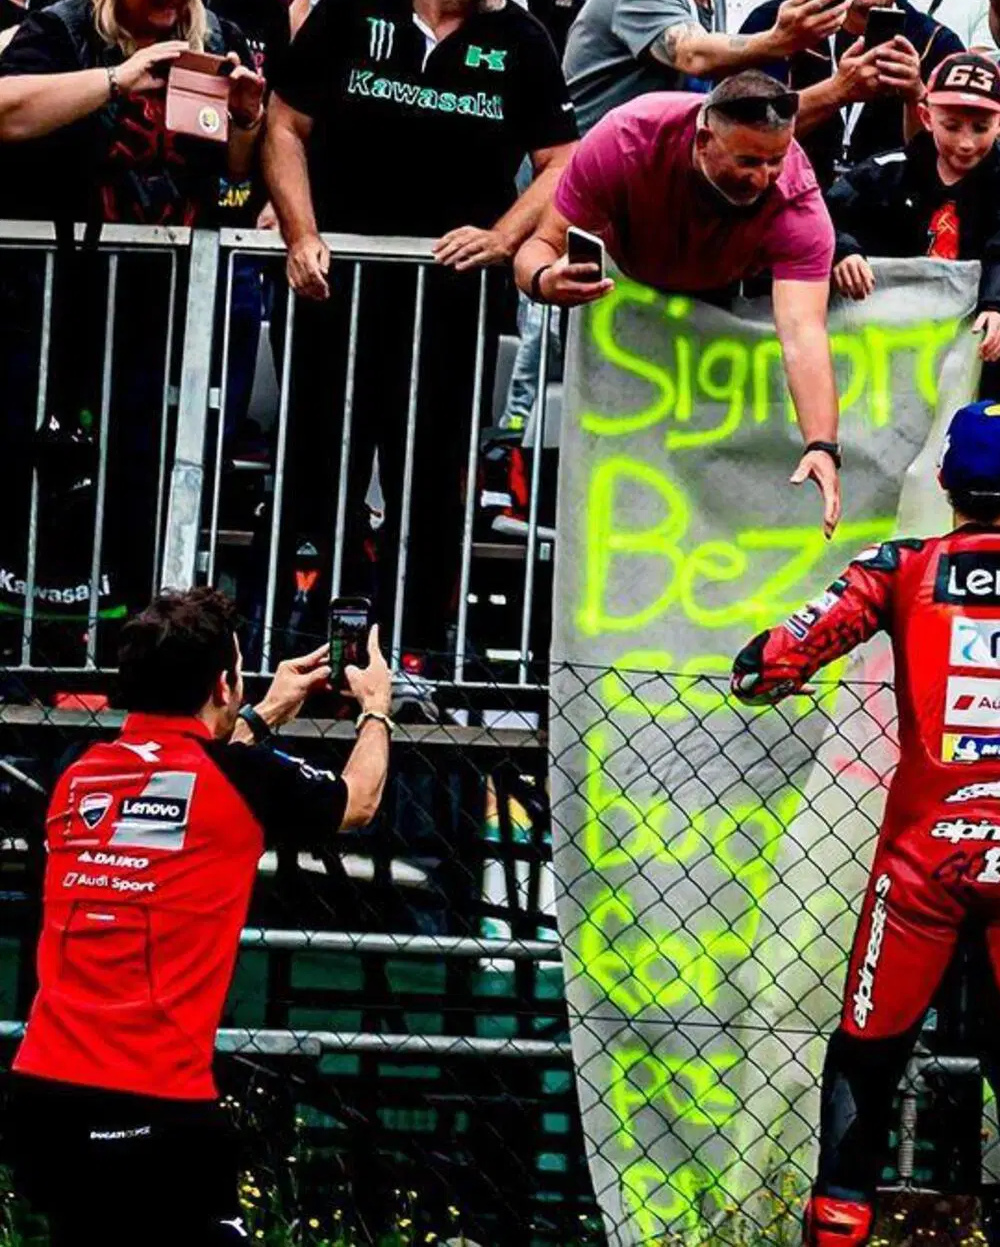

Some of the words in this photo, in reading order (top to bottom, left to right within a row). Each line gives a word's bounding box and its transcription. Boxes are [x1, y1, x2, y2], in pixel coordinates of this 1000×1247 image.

[944, 64, 996, 92] 63
[347, 69, 505, 121] Kawasaki
[122, 799, 181, 817] Lenovo
[77, 874, 109, 887] Audi
[111, 876, 156, 892] Sport
[853, 873, 892, 1029] alpinestars
